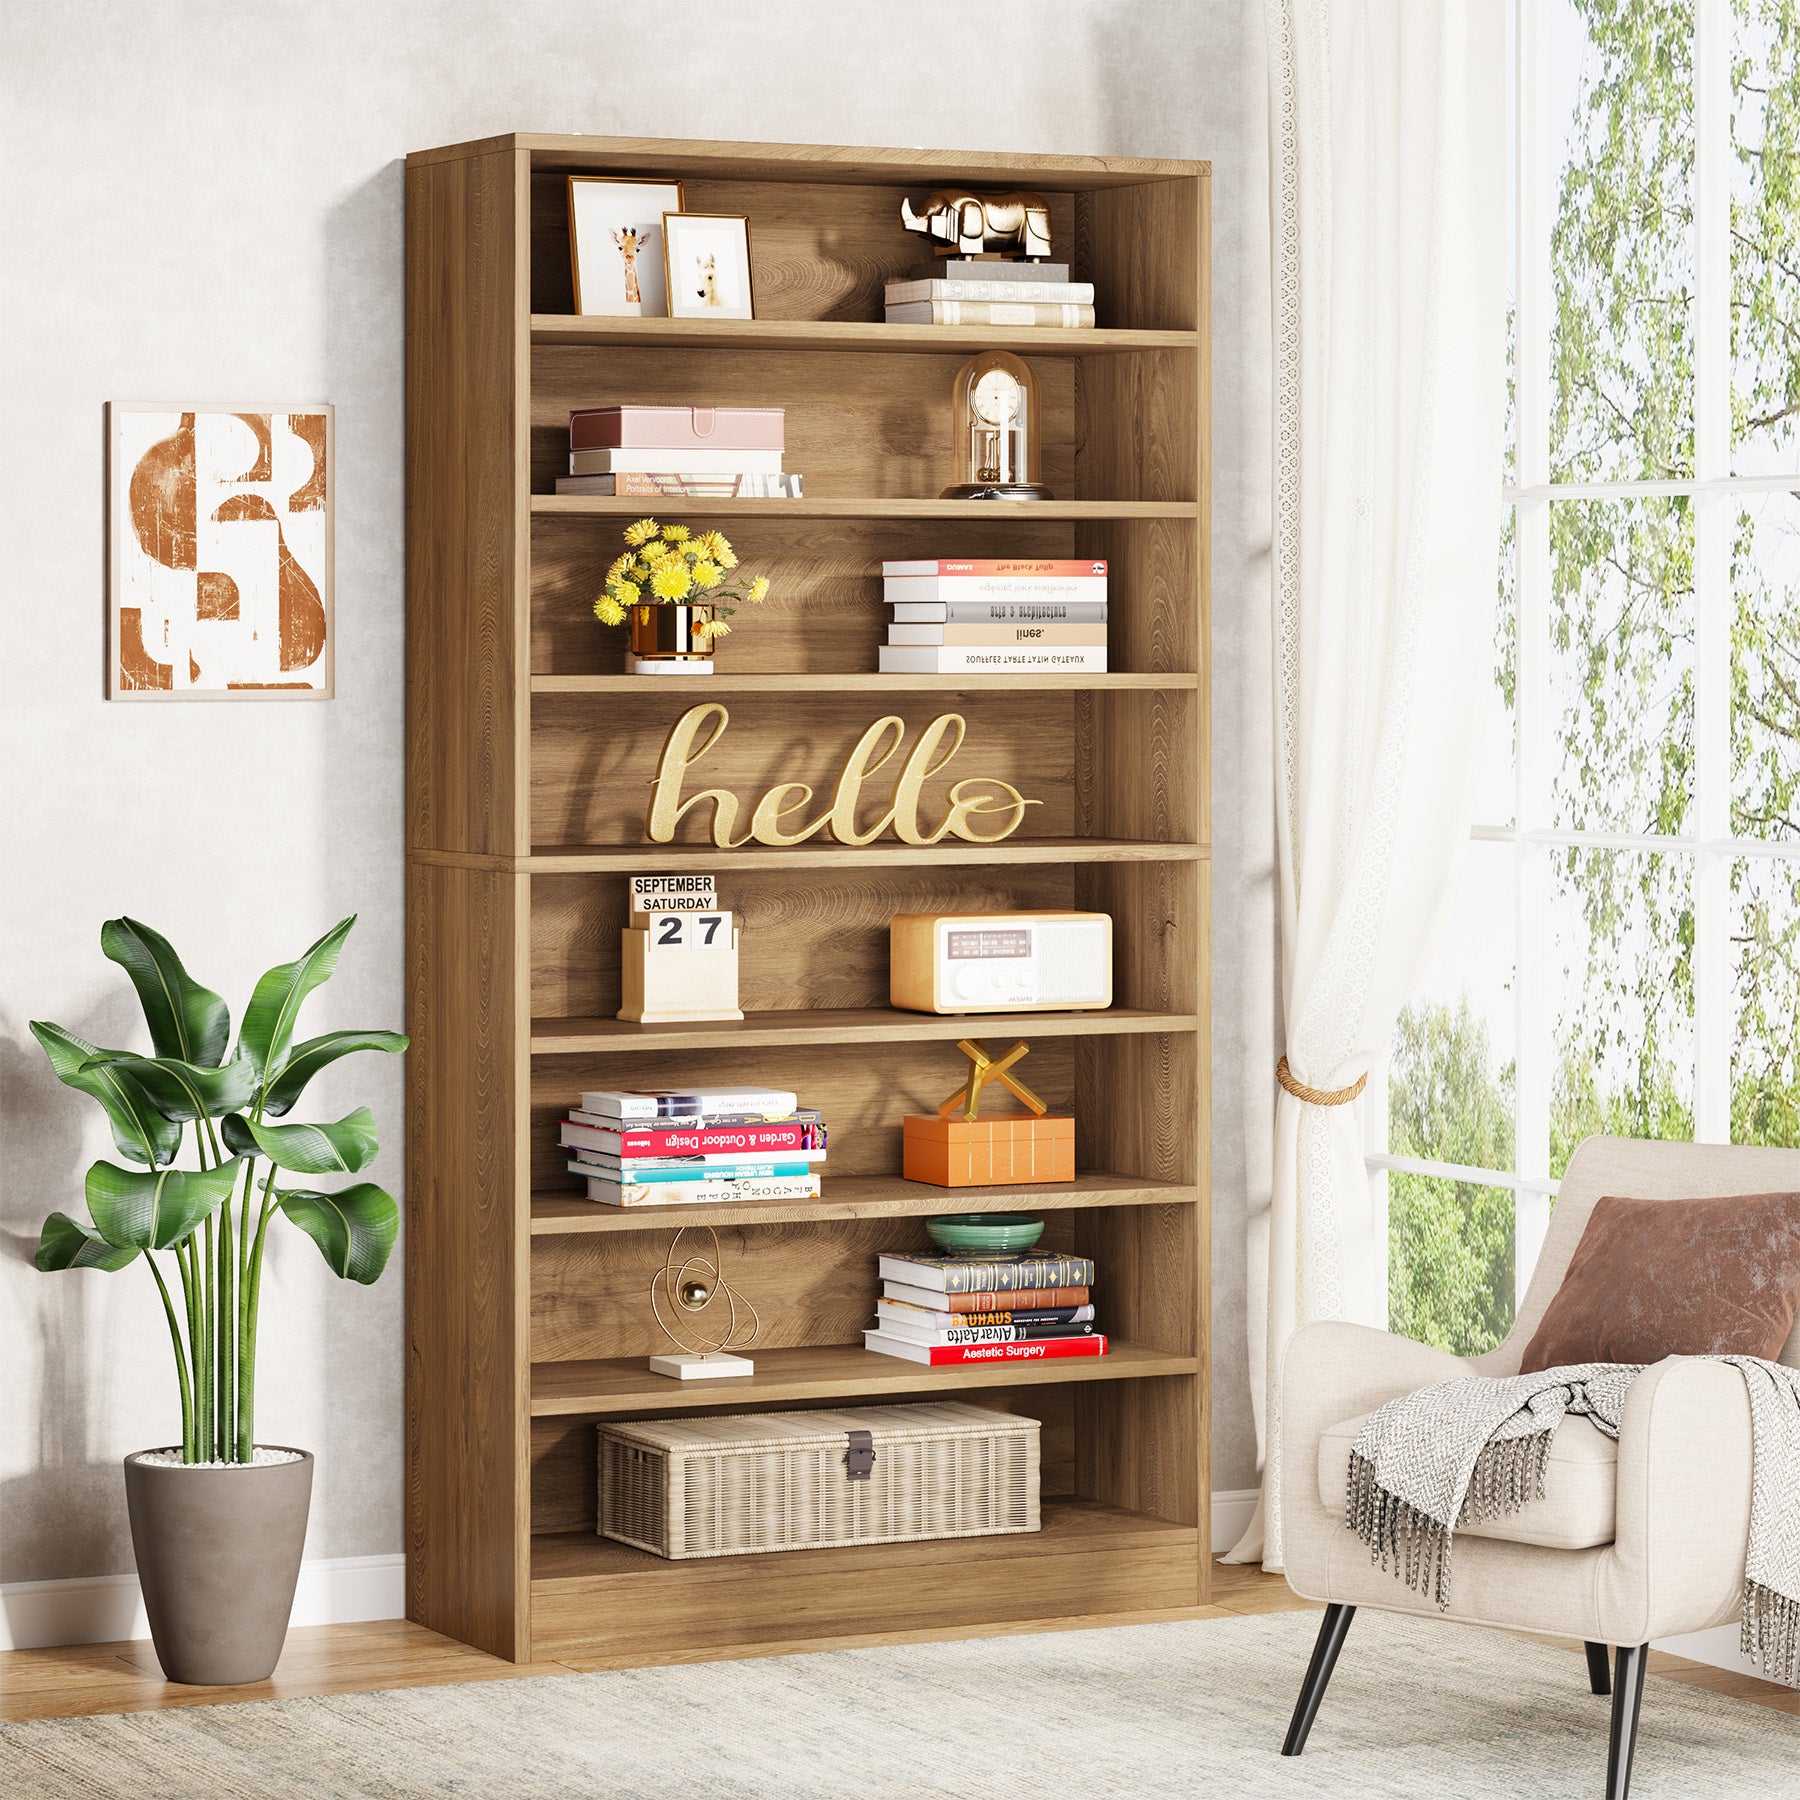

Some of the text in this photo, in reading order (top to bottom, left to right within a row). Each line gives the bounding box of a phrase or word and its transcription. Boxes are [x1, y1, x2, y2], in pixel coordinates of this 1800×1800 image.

[646, 702, 1044, 848] hello
[635, 877, 712, 893] SEPTEMBER
[643, 897, 712, 910] SATURDAY
[665, 1132, 796, 1149] Garden & Outdoor Design
[951, 1311, 1012, 1327] BAUHAUS
[962, 1345, 1046, 1359] Aestetic Surgery
